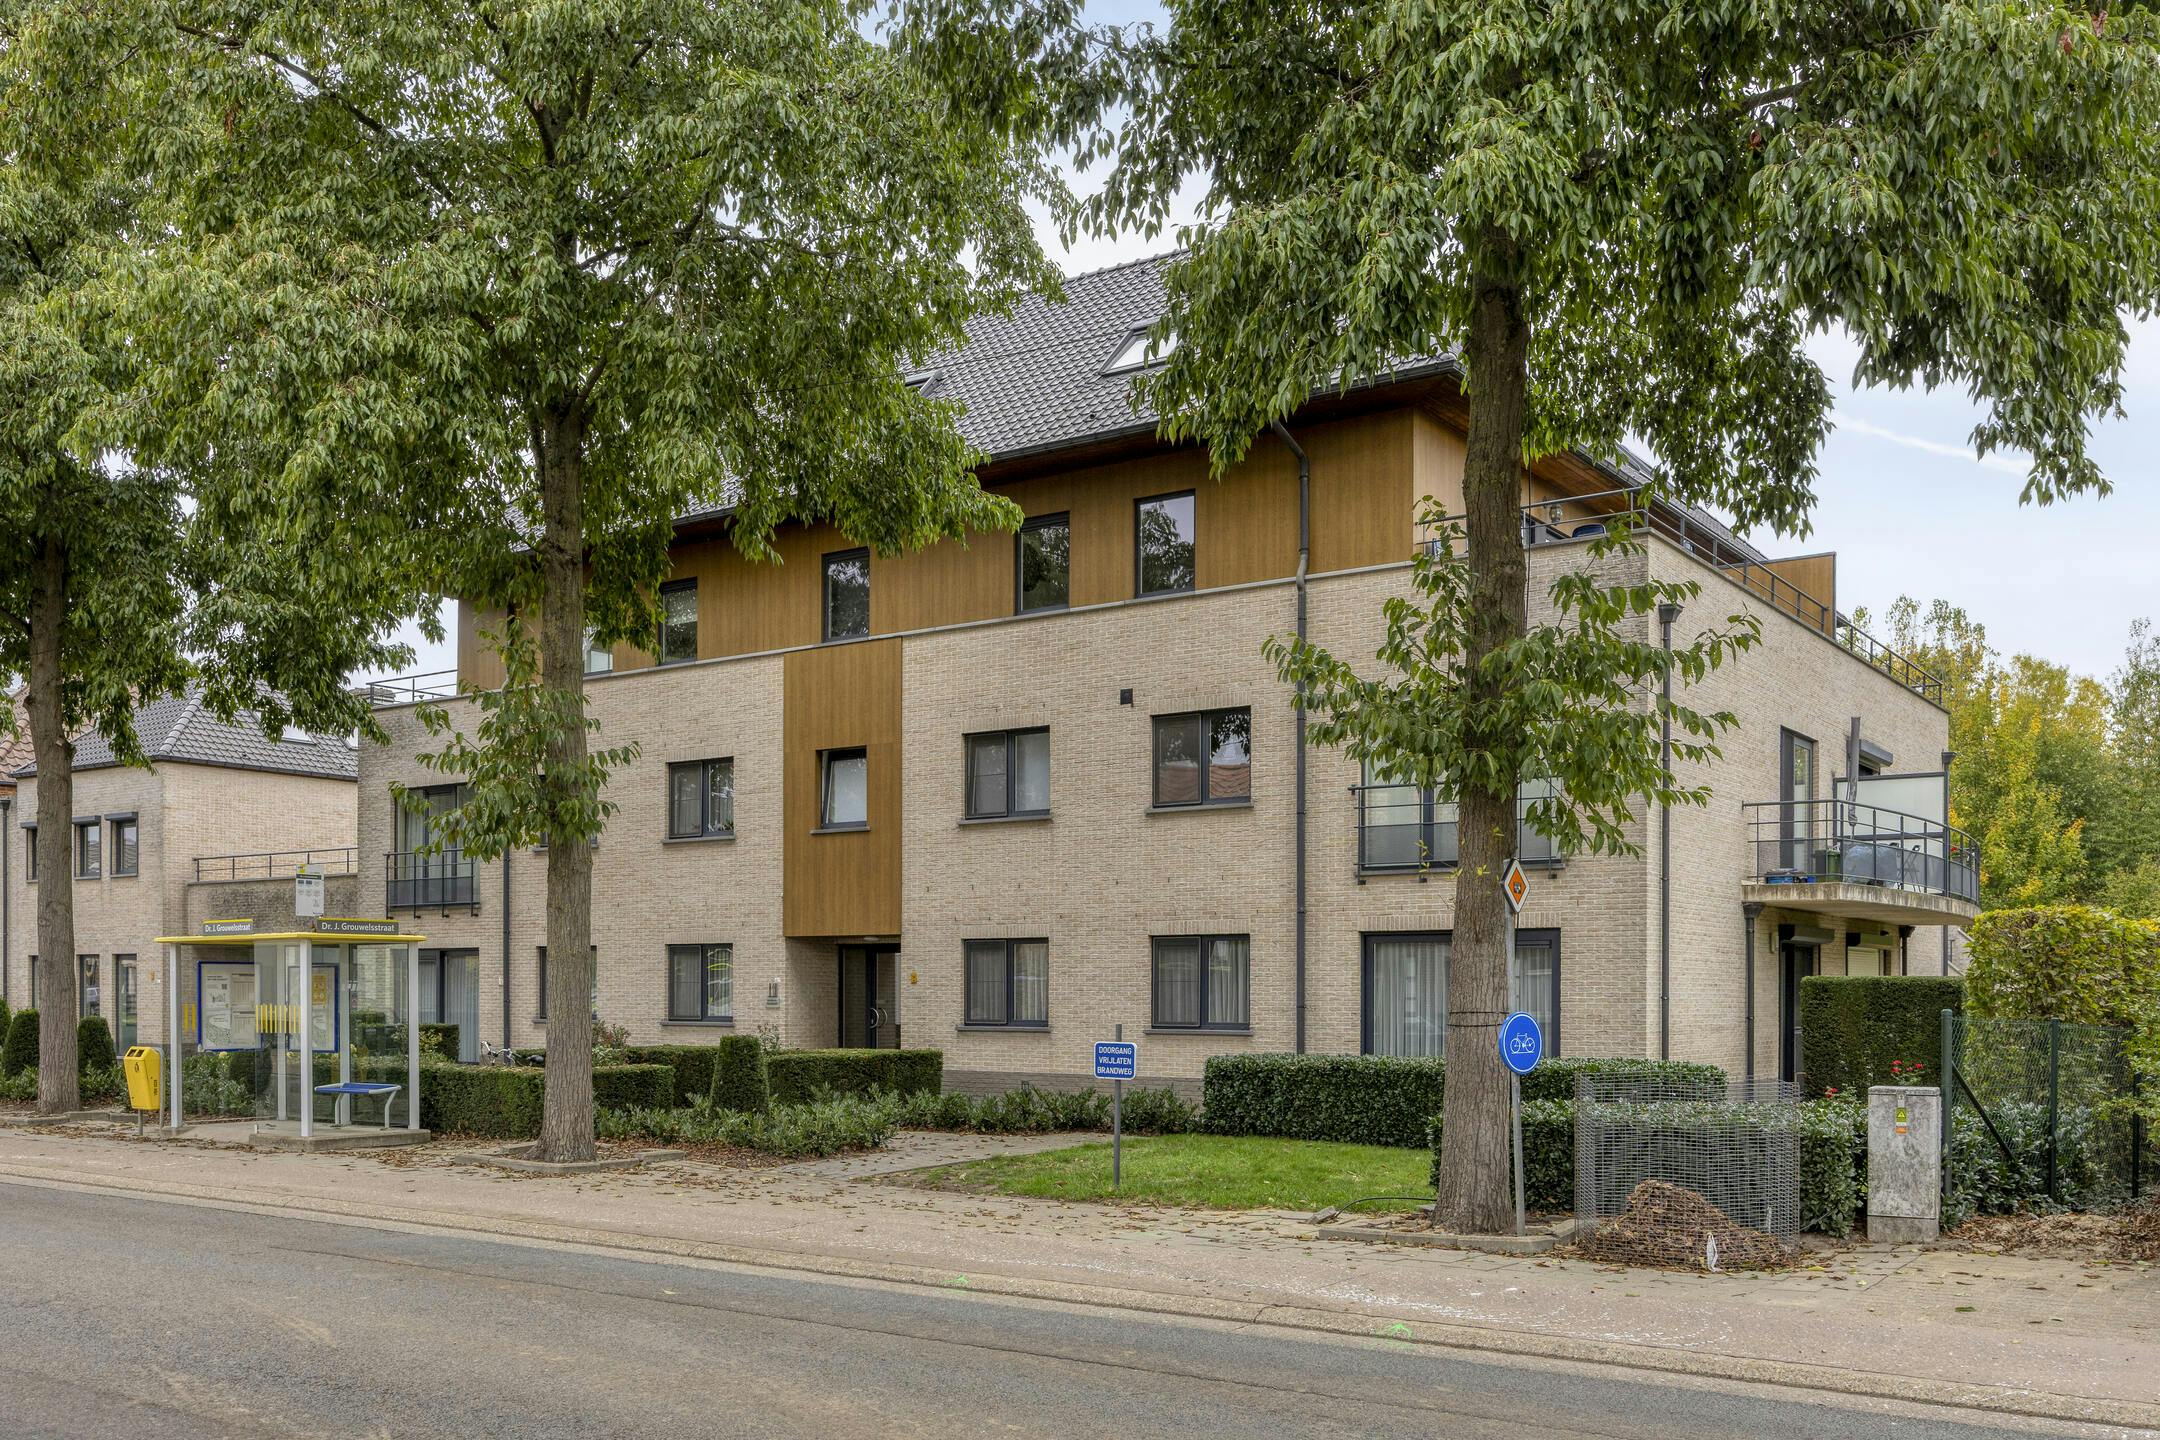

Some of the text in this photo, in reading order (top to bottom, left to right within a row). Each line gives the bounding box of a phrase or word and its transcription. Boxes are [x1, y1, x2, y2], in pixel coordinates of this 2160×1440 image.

[217, 924, 251, 932] Grouwelsstraat
[321, 922, 395, 932] Dr. J. Grouwelsstraat
[1098, 1046, 1132, 1054] DOORGANG
[1097, 1067, 1132, 1075] BRANDWEG
